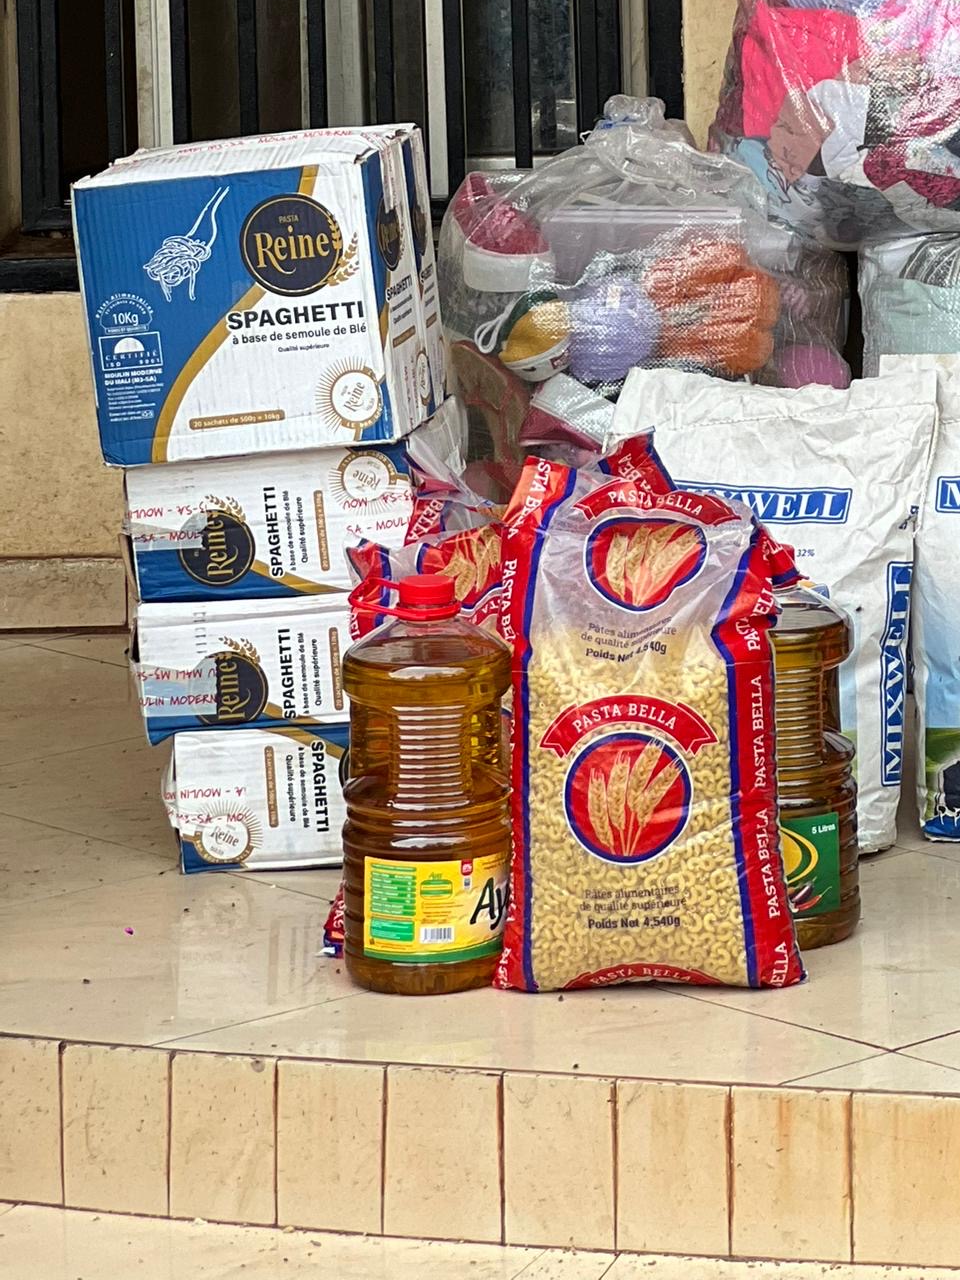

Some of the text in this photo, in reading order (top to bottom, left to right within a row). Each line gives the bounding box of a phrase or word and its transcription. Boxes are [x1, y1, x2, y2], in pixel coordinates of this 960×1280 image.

[278, 214, 299, 224] PASTA
[254, 225, 329, 275] Reine
[386, 274, 413, 302] SPAGHETTI
[112, 312, 139, 327] 10Kg
[228, 300, 365, 330] SPAGHETTI
[232, 322, 367, 345] à base de semoule de Blé
[105, 368, 163, 379] MOULIN MODERNE
[203, 417, 239, 427] sachets de
[608, 490, 652, 508] PASTA
[263, 486, 283, 578] SPAGHETTI
[285, 512, 293, 539] semoule
[295, 496, 309, 564] Qualité supérieure
[796, 549, 815, 558] 32%
[501, 559, 517, 611] PASTA
[581, 632, 630, 649] de qualité
[586, 648, 615, 661] Poids
[278, 628, 297, 720] SPAGHETTI
[309, 639, 322, 706] Qualité supérieure
[572, 702, 677, 734] PASTA BELLA
[752, 675, 766, 789] PASTA BELLA
[285, 755, 297, 822] Qualité supérieure
[312, 741, 329, 833] SPAGHETTI
[756, 807, 780, 918] PASTA BELLA
[580, 897, 688, 913] de qualité supérieure
[615, 885, 680, 899] alimentaires
[588, 918, 618, 929] Poids
[620, 918, 640, 928] Net
[642, 967, 692, 982] BELLA
